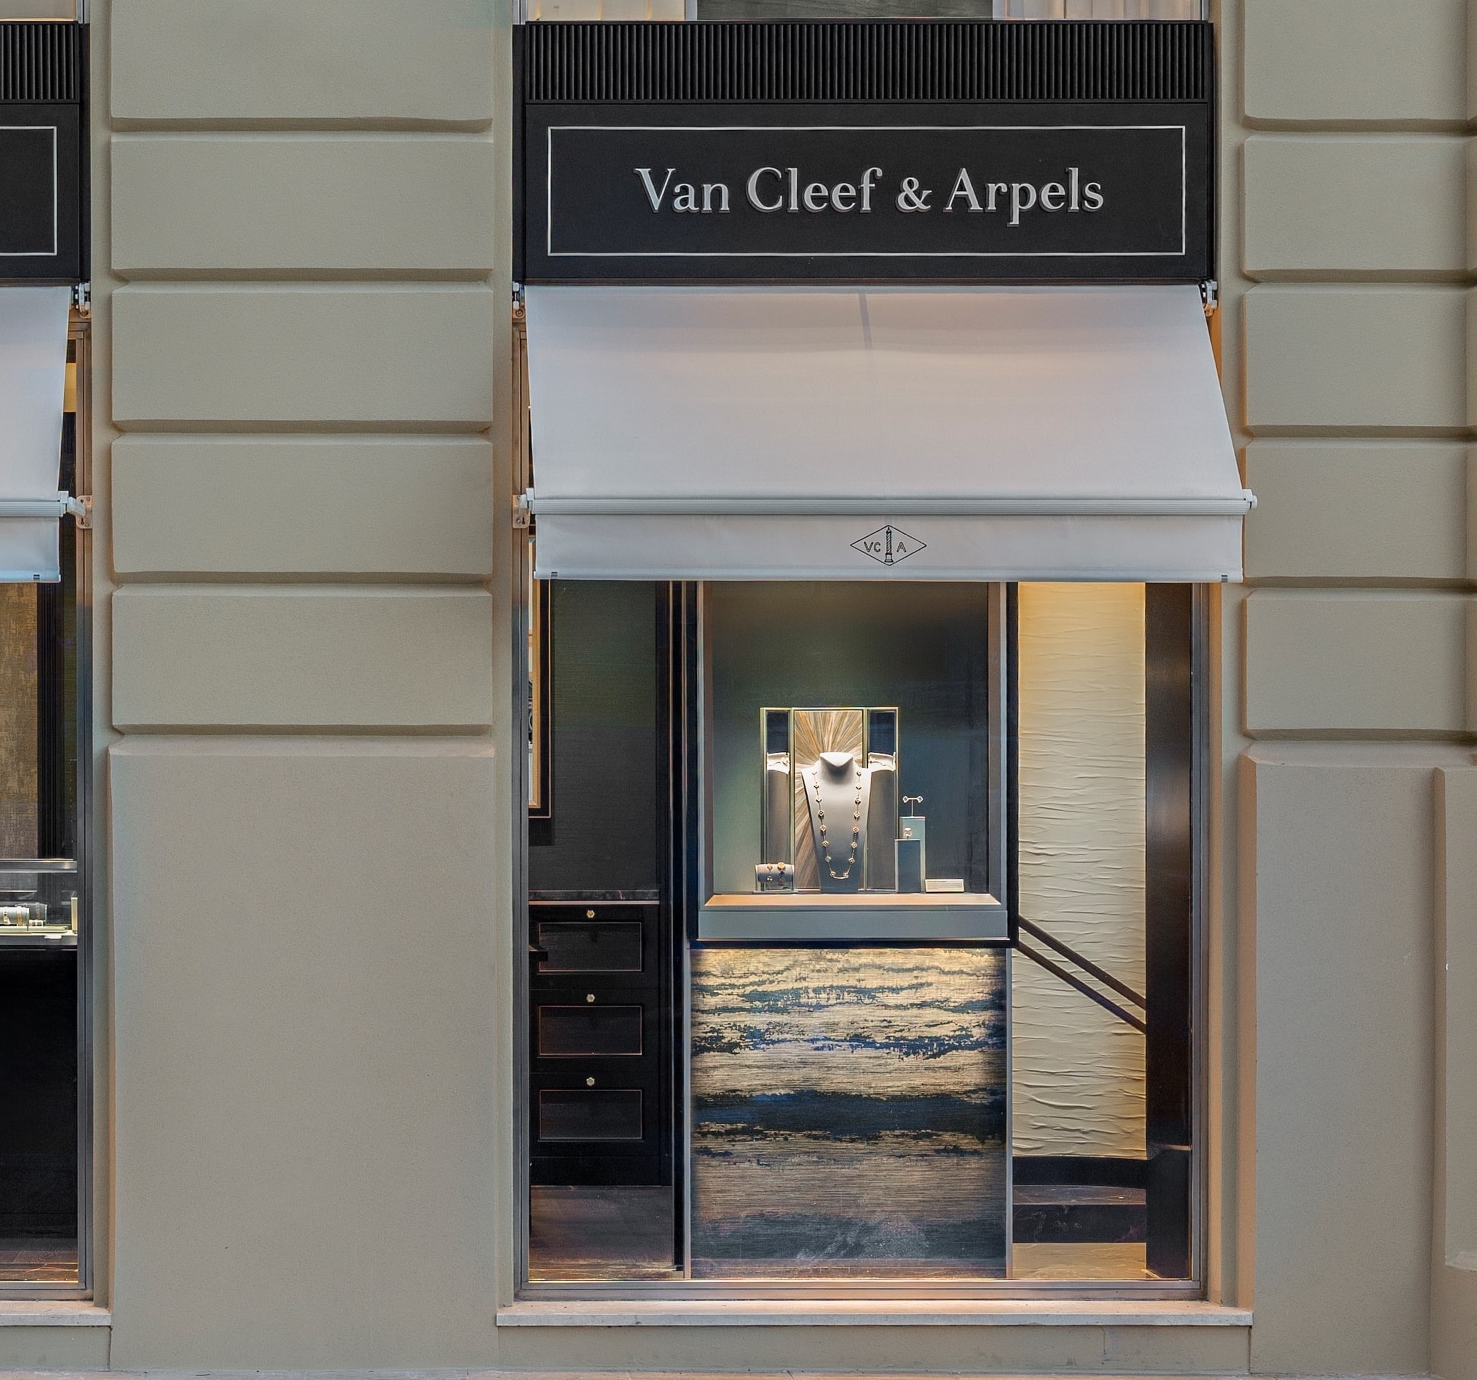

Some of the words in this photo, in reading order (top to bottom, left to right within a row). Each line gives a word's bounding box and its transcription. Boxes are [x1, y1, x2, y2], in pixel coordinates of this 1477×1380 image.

[633, 167, 730, 214] Van
[745, 166, 883, 214] Cleef
[895, 176, 933, 214] &
[942, 166, 1104, 229] Arpels
